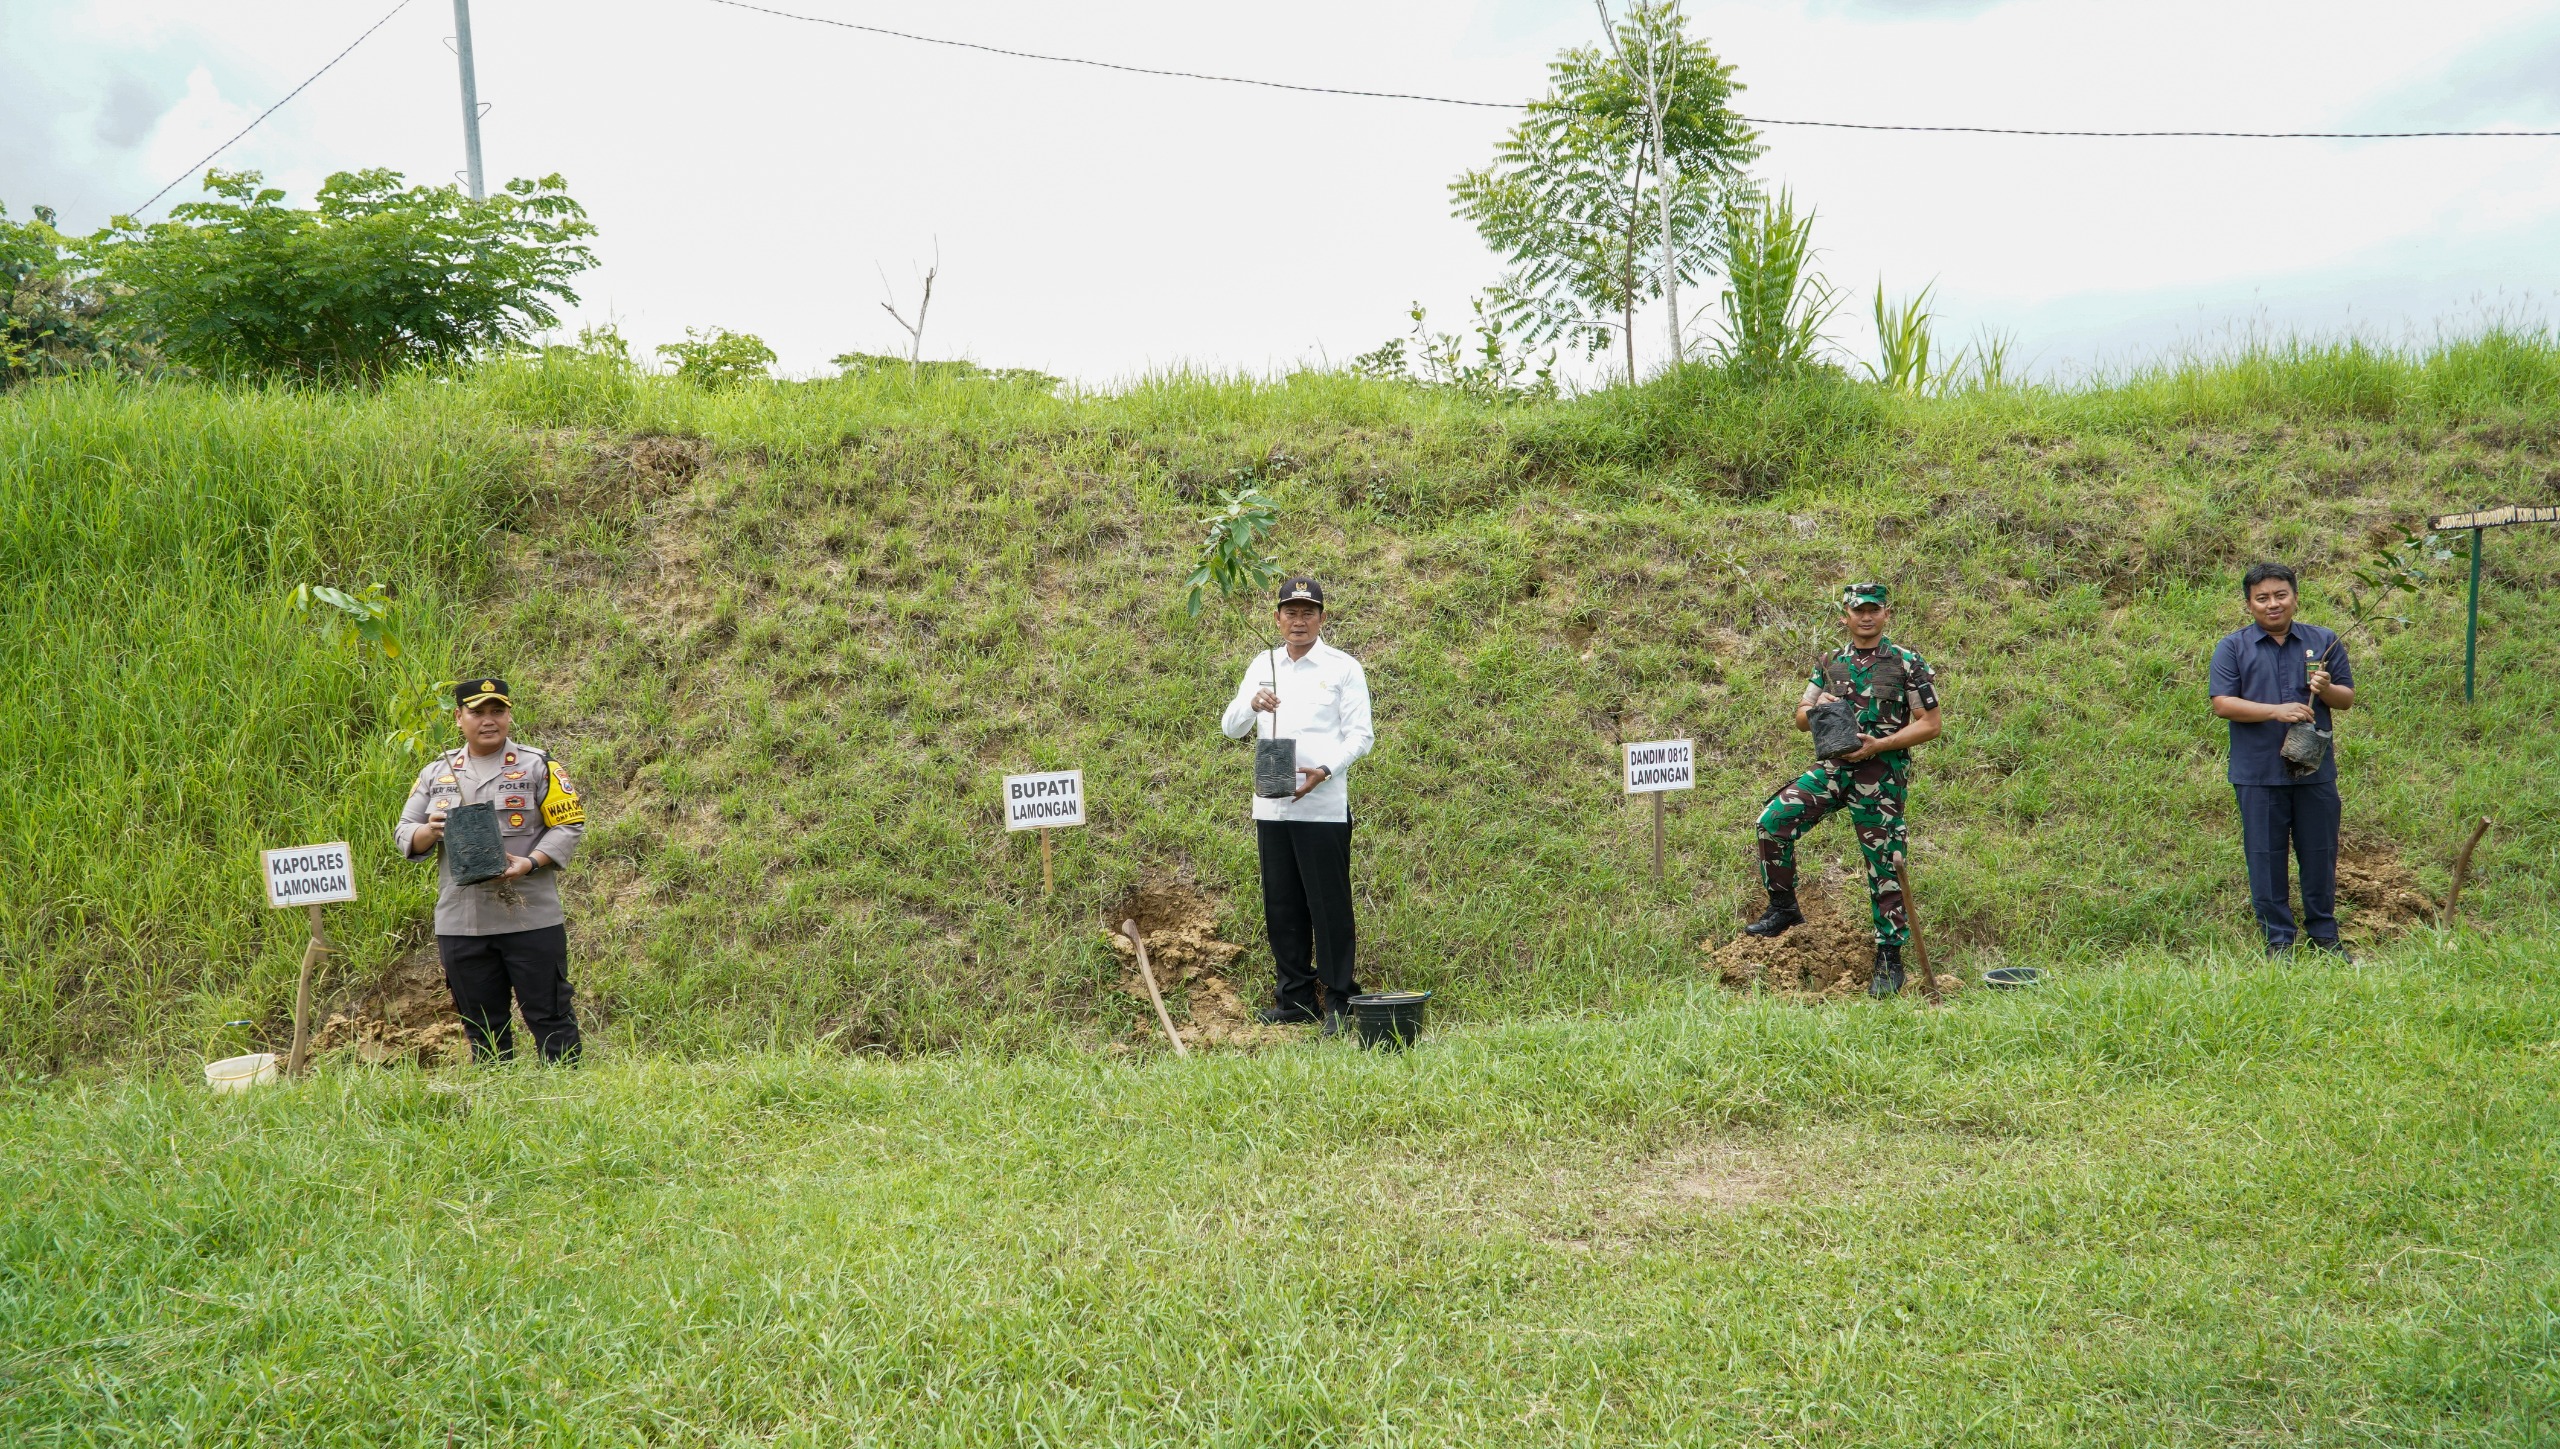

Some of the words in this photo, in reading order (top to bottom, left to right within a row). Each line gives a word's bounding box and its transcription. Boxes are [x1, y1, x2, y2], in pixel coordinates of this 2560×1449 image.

[1630, 748, 1666, 766] DANDIM
[1667, 746, 1689, 763] 0812
[1631, 766, 1689, 786] LAMONGAN
[498, 782, 530, 791] POLRI
[1011, 779, 1076, 800] BUPATI
[547, 800, 574, 818] WAKA
[1012, 800, 1077, 821] LAMONGAN
[272, 853, 344, 875] KAPOLRES
[275, 874, 347, 897] LAMONGAN
